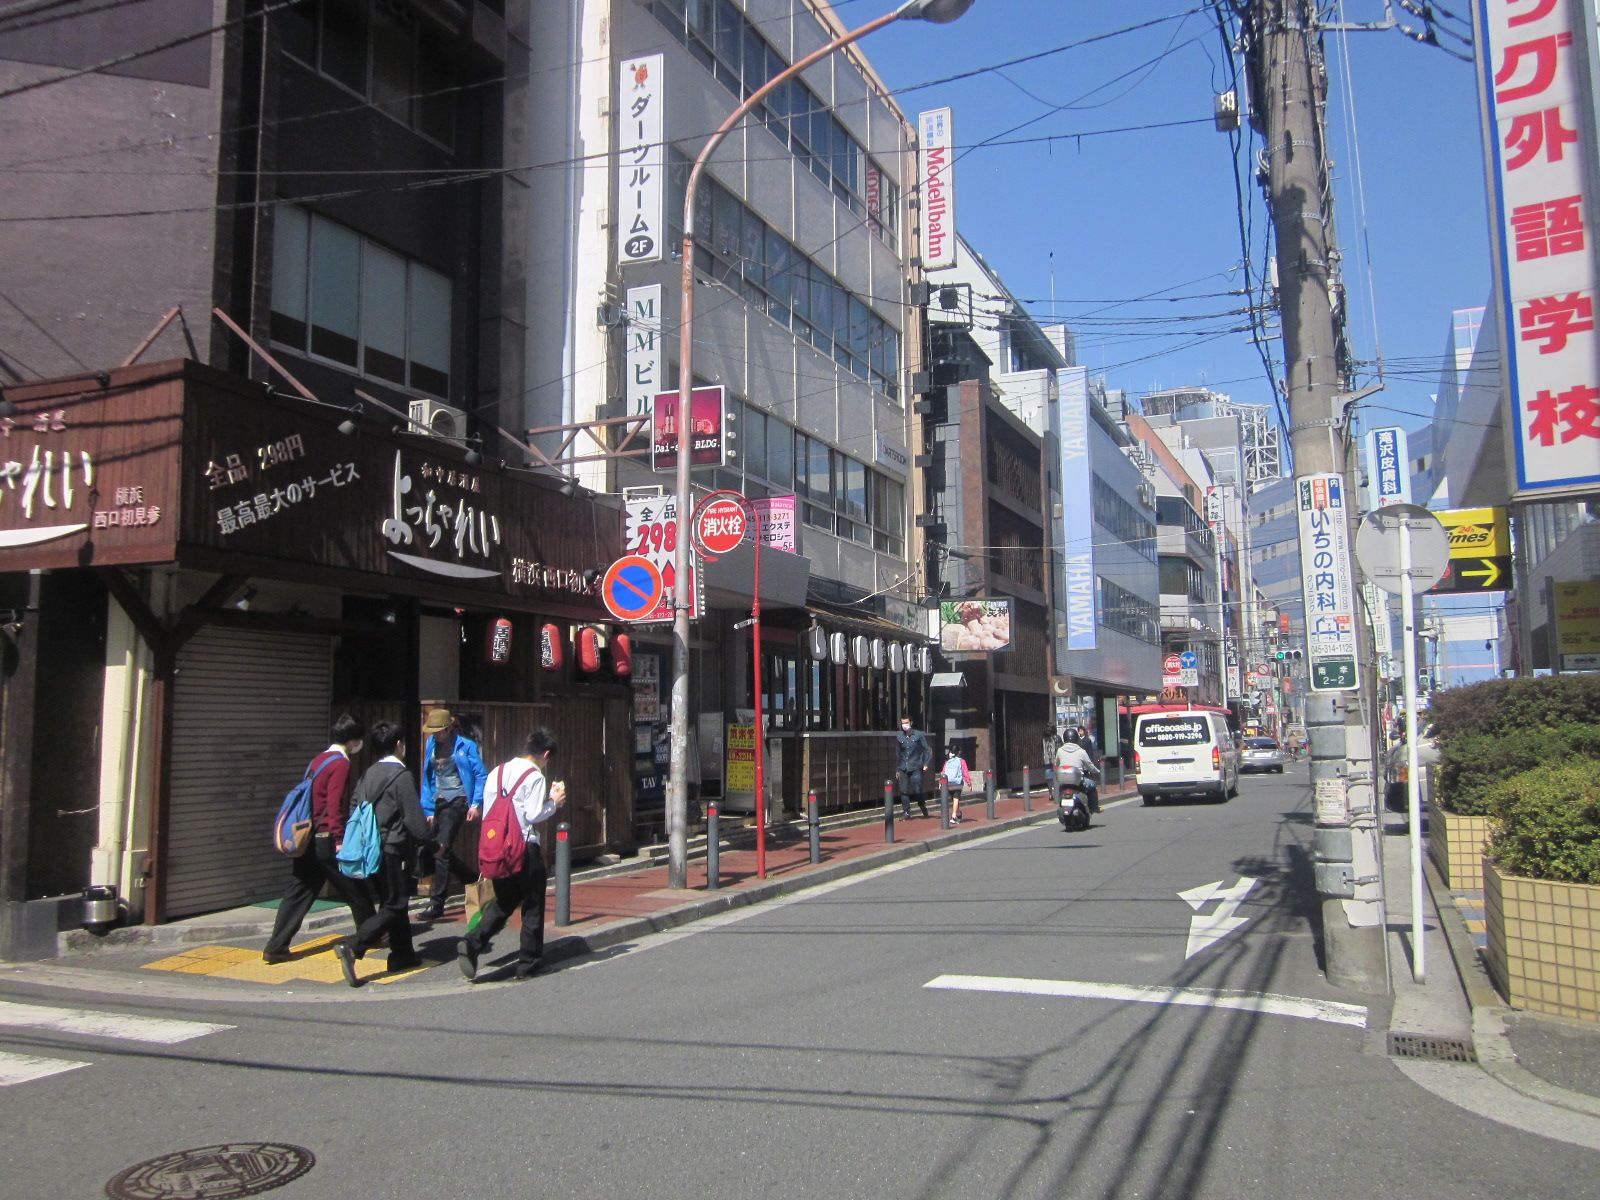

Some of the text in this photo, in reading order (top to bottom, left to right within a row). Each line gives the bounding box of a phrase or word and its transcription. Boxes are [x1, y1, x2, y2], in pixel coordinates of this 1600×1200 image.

[630, 94, 651, 254] ダーツルーム 2F
[927, 146, 946, 259] Modellbahn
[1494, 0, 1600, 447] グ外語学校
[635, 298, 654, 416] MMビル
[1066, 377, 1087, 461] YAMAHA
[204, 433, 306, 490] 全品 298円
[1331, 480, 1340, 507] 内科
[217, 462, 361, 535] 最高最大のサービス
[640, 505, 676, 522] 全品
[703, 515, 742, 537] 消火栓
[1311, 511, 1336, 611] いちの内科
[1446, 530, 1489, 543] imes
[1069, 552, 1093, 638] YAMAHA
[1323, 675, 1345, 685] 2-2
[1145, 722, 1202, 733] officeoasis.jp
